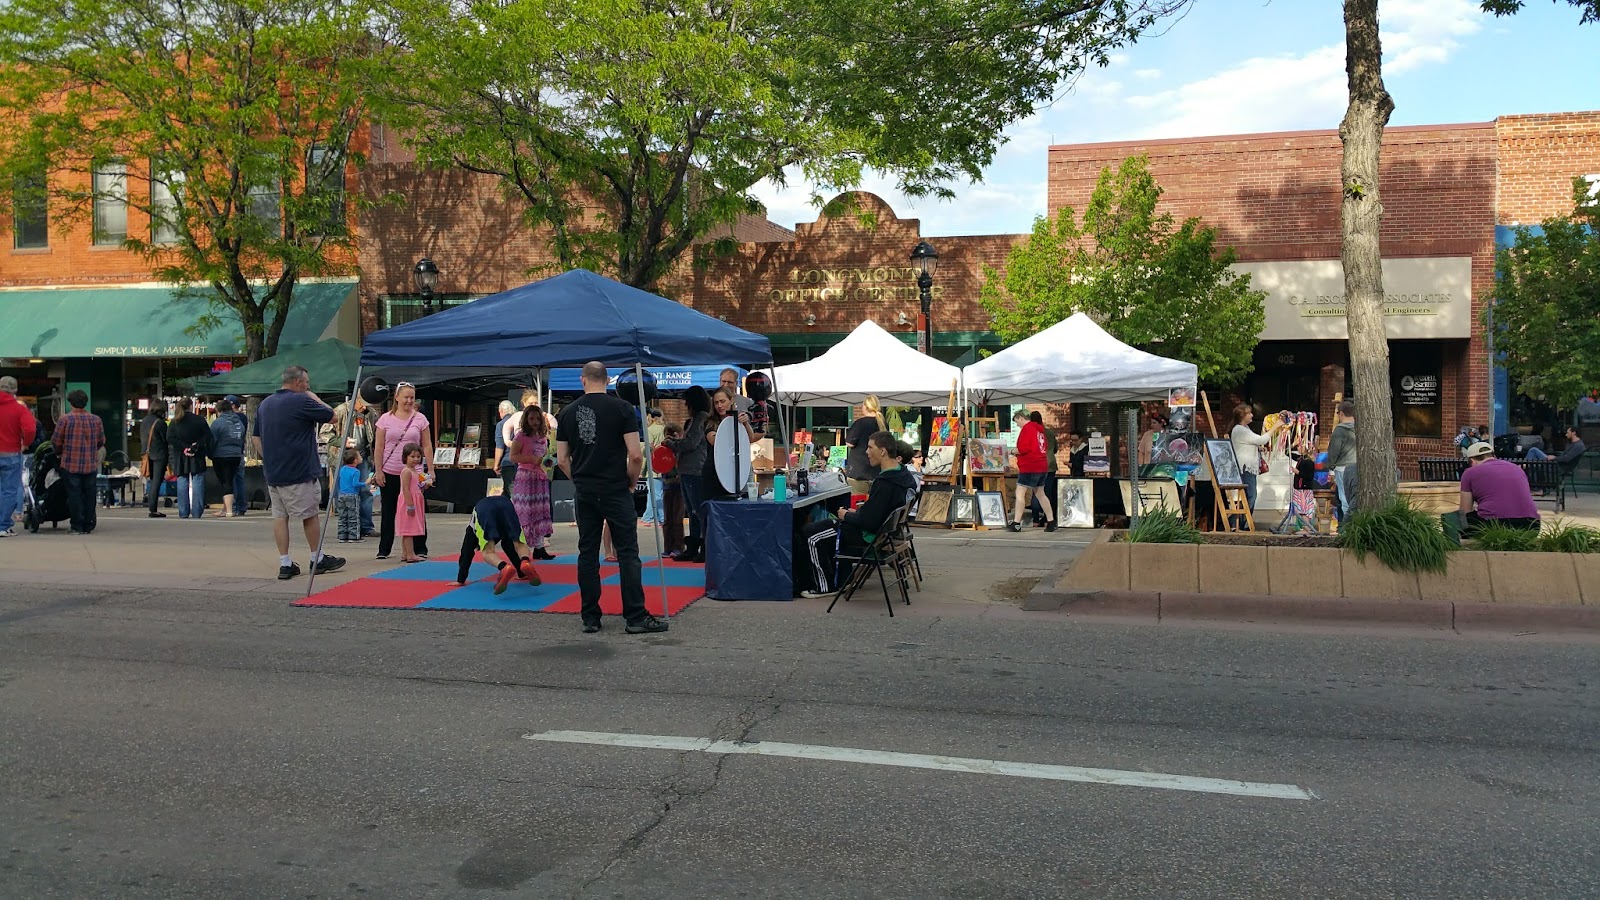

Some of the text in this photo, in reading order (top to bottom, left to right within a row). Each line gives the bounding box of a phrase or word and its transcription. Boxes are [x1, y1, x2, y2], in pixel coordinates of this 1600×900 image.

[790, 267, 921, 284] LONGMONT
[769, 287, 849, 303] OFFICE
[1308, 308, 1347, 316] Consultin
[1392, 307, 1431, 315] Engineers
[94, 346, 208, 356] SIMPLY BULK MARKET
[1278, 354, 1295, 364] 402
[666, 371, 692, 380] RANGE
